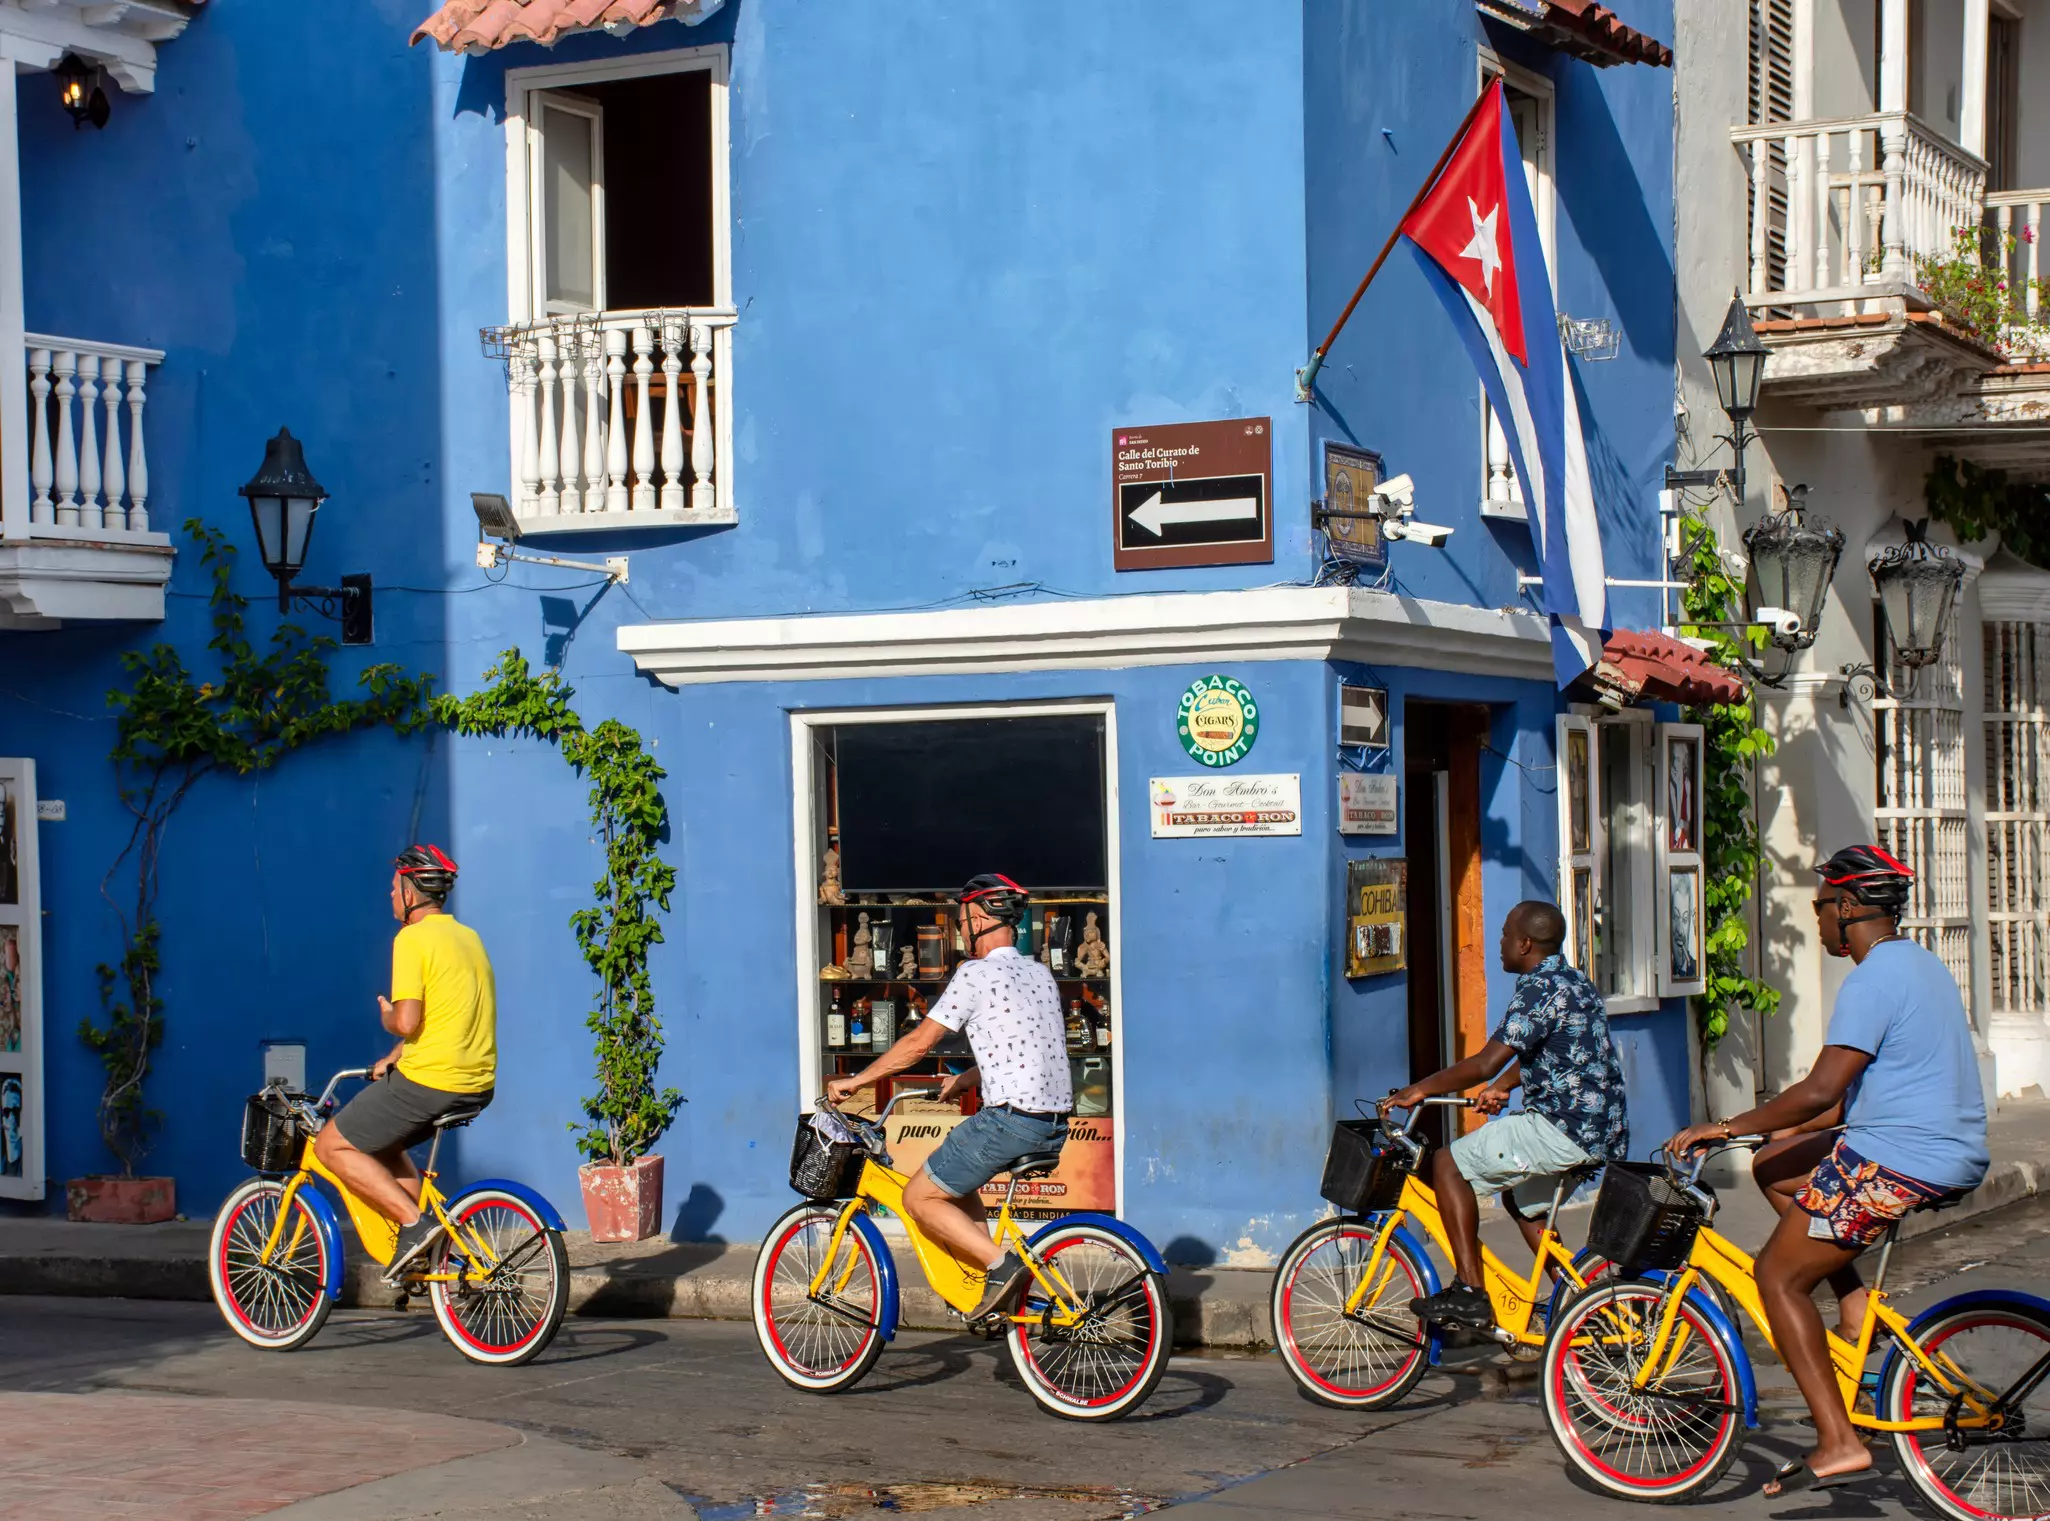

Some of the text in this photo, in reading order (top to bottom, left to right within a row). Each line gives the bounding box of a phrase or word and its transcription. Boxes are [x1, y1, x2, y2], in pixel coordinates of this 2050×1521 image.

[1119, 444, 1200, 460] Calle del Curato de
[1119, 458, 1178, 471] Santo Toribio
[1177, 675, 1257, 719] TOBACCO
[1195, 714, 1235, 728] CIGARS
[1188, 736, 1248, 766] POINT
[1187, 782, 1217, 797] Don
[1173, 812, 1295, 823] TABACO RON
[1193, 827, 1211, 835] puro
[1212, 825, 1232, 833] sabor
[1361, 888, 1398, 917] COHIBA
[896, 1125, 942, 1145] puro
[982, 1184, 1066, 1194] TABCO RON
[1023, 1211, 1035, 1219] DE
[1501, 1295, 1518, 1311] 16
[1055, 1390, 1089, 1406] SCHWALBE
